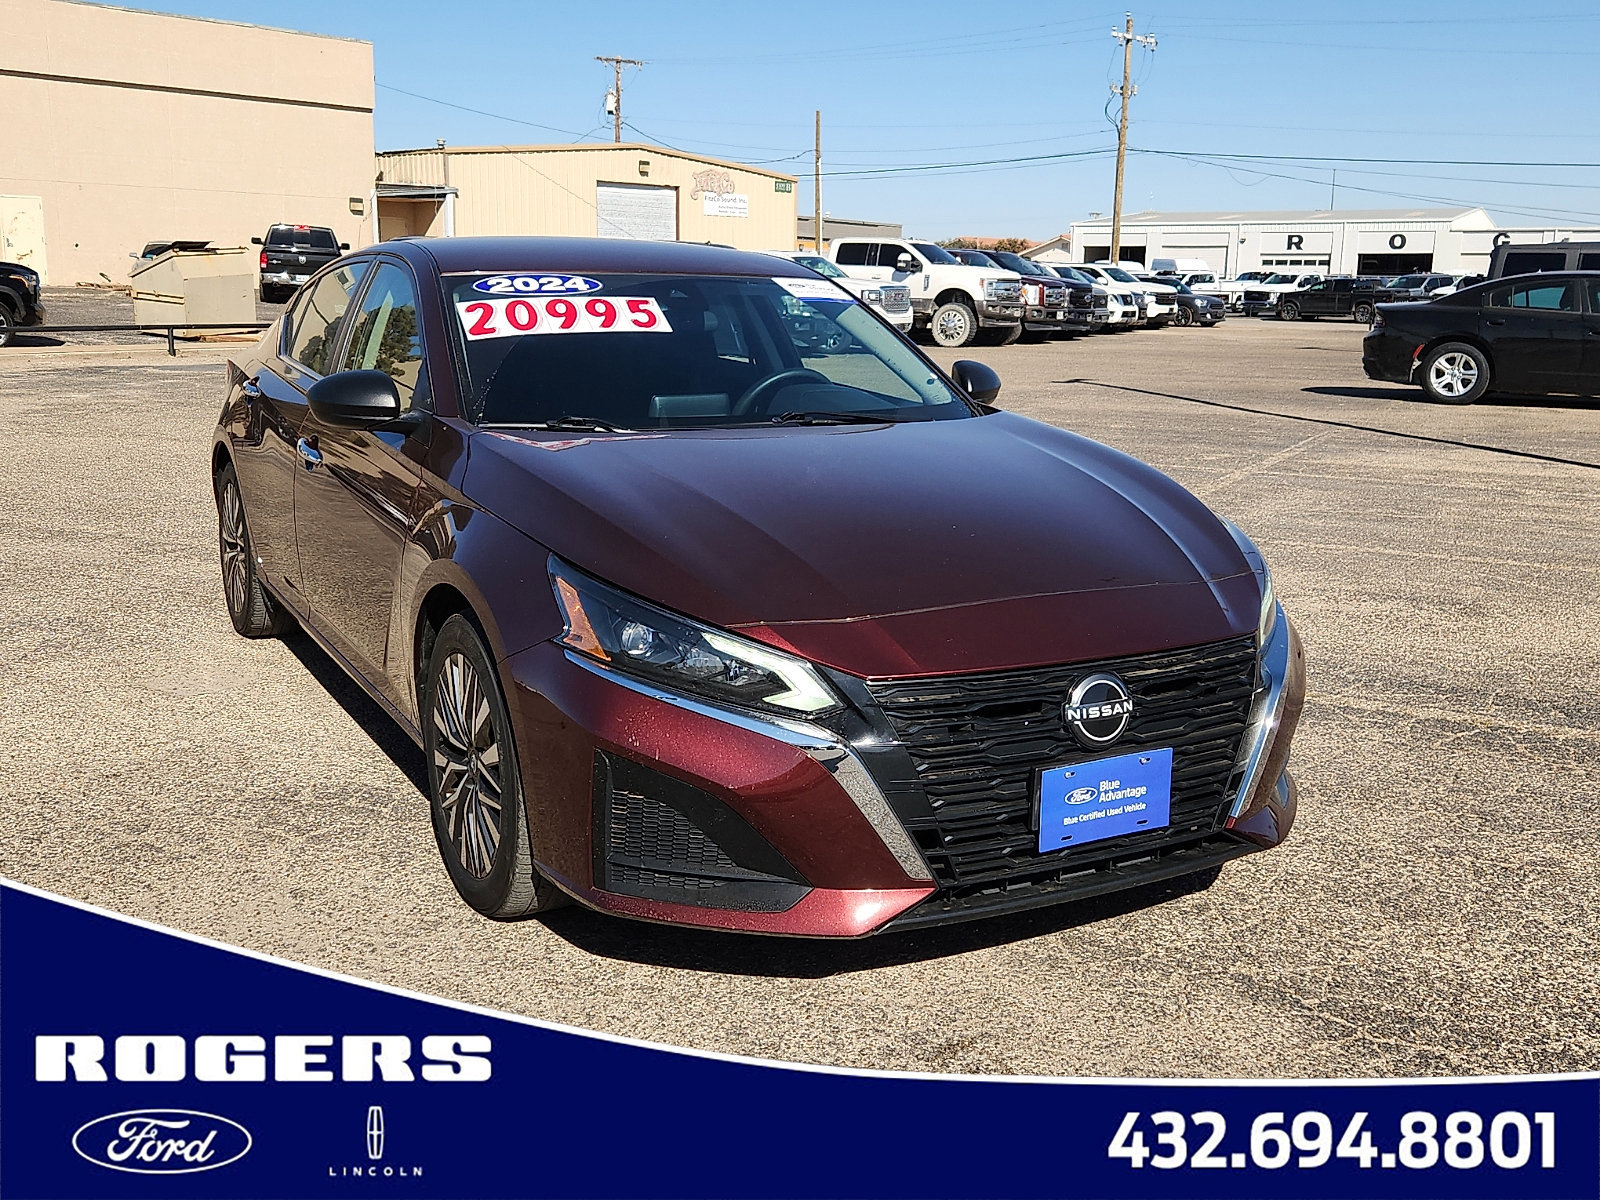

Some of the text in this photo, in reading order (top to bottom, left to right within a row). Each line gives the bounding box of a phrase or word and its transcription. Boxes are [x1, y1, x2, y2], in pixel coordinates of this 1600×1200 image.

[1286, 234, 1304, 251] R
[1388, 233, 1407, 250] O
[487, 277, 590, 292] 2024
[465, 299, 657, 336] 20995
[1067, 700, 1133, 720] NISSAN
[1098, 786, 1147, 803] Advantage
[1099, 780, 1120, 792] Blue
[1070, 789, 1093, 803] Ford
[1063, 802, 1147, 826] Blue Certified Used Vehicle
